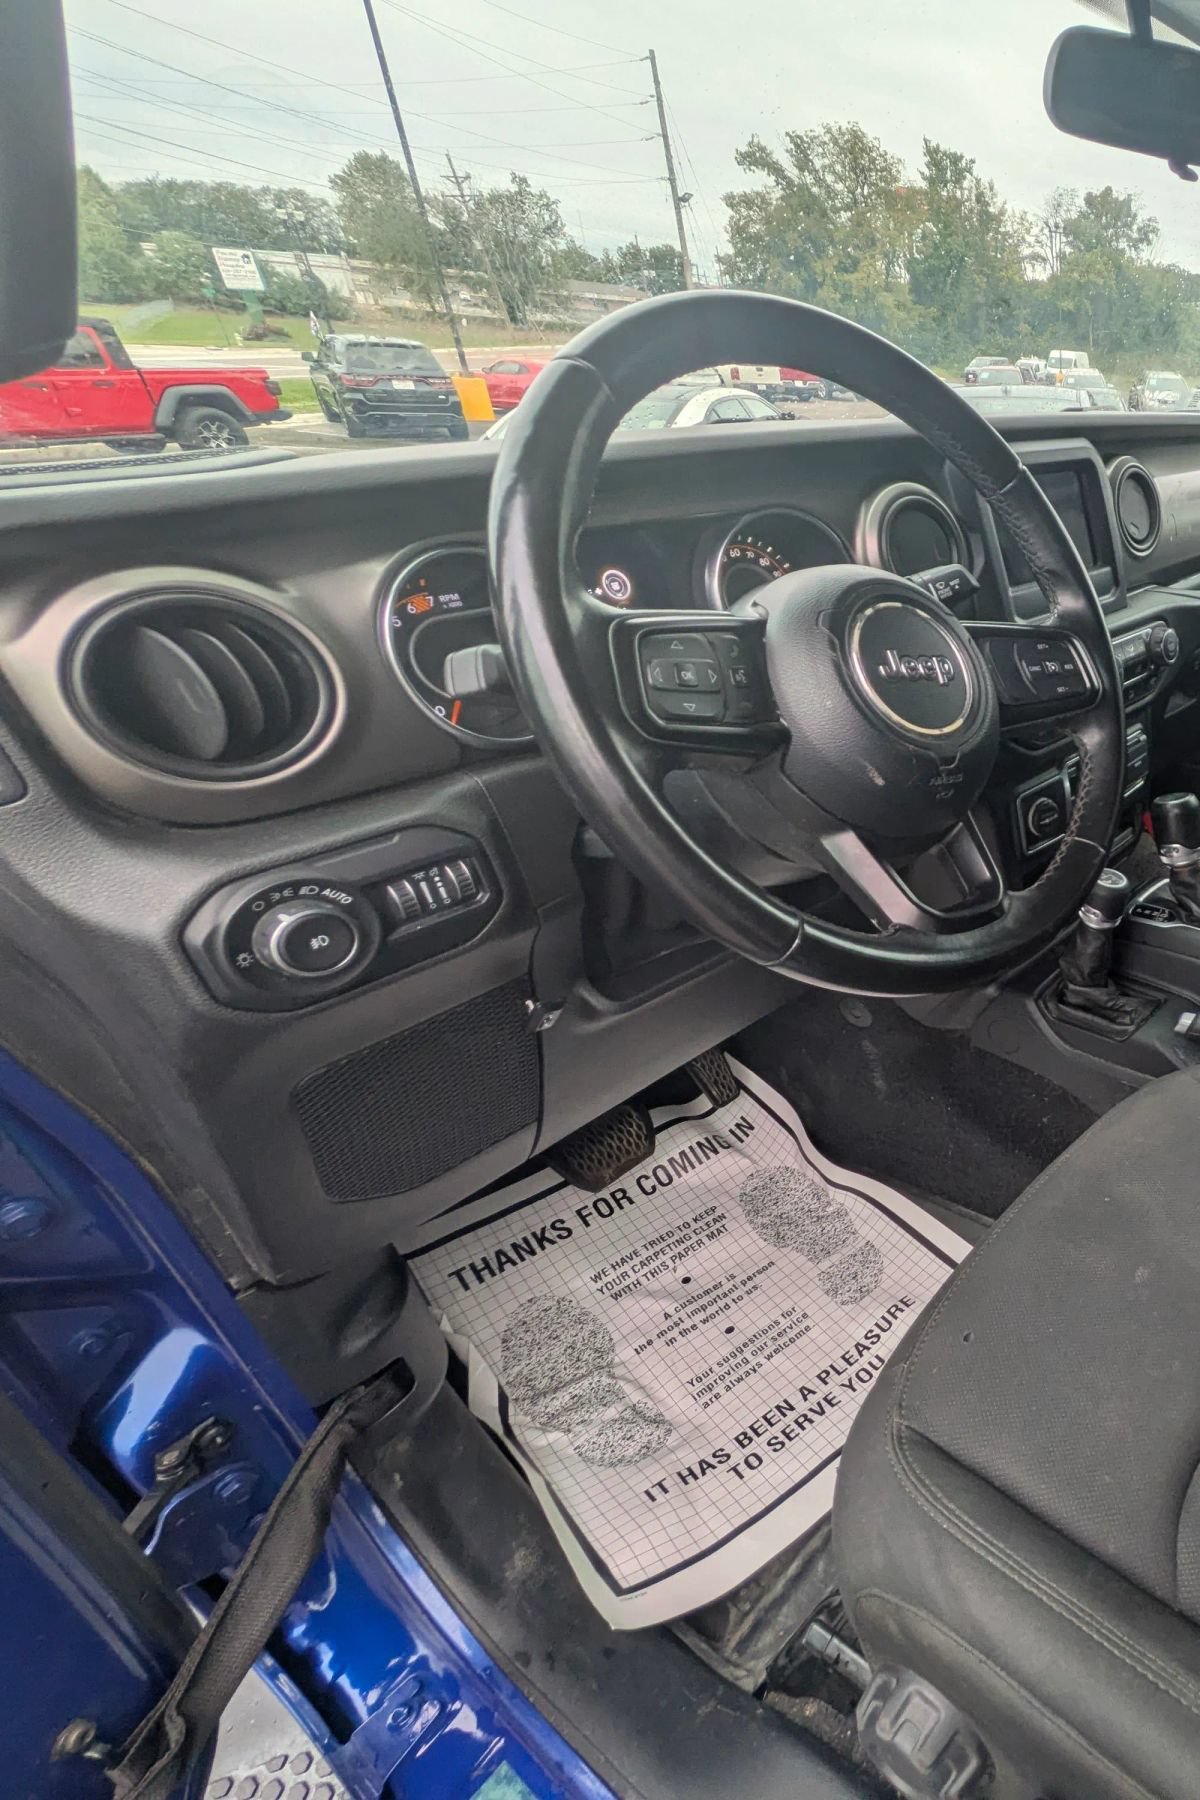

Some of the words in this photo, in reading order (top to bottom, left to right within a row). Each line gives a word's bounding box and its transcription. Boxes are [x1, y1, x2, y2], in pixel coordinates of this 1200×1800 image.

[730, 548, 741, 557] 60
[759, 557, 770, 566] 80
[391, 615, 402, 627] 5
[407, 603, 417, 614] 6
[426, 596, 434, 607] 7
[439, 593, 460, 602] RPM
[879, 649, 955, 686] Jeep
[435, 705, 446, 717] 0
[321, 887, 353, 904] AUTO
[448, 1218, 573, 1292] THANKS
[575, 1187, 635, 1228] FOR
[636, 1134, 732, 1196] COMING
[728, 1115, 756, 1143] IN
[590, 1267, 611, 1284] WE
[611, 1248, 642, 1271] HAVE
[641, 1230, 675, 1252] TRIED
[675, 1221, 691, 1233] TO
[692, 1205, 718, 1224] KEEP
[596, 1271, 631, 1296] YOUR
[631, 1233, 692, 1274] CARPETING
[693, 1212, 727, 1236] CLEAN
[610, 1278, 642, 1301] WITH
[641, 1261, 670, 1282] THIS
[670, 1239, 706, 1264] PAPER
[706, 1223, 729, 1242] MAT
[634, 1338, 654, 1355] the
[656, 1316, 685, 1339] most
[685, 1283, 739, 1319] important
[740, 1260, 776, 1287] person
[663, 1311, 673, 1321] A
[674, 1280, 723, 1313] customer
[724, 1272, 737, 1282] is
[664, 1335, 678, 1347] in
[678, 1322, 699, 1338] the
[699, 1303, 731, 1325] world
[731, 1294, 744, 1305] to
[686, 1365, 715, 1388] Your
[716, 1318, 782, 1368] suggestions
[780, 1305, 798, 1320] for
[691, 1355, 750, 1401] improving
[750, 1339, 770, 1357] our
[770, 1311, 809, 1342] service
[644, 1477, 670, 1503] IT
[676, 1447, 732, 1486] HAS
[733, 1398, 796, 1449] BEEN
[798, 1385, 818, 1402] A
[816, 1295, 917, 1386] PLEASURE
[702, 1391, 722, 1410] are
[723, 1360, 763, 1393] always
[726, 1452, 764, 1480] TO
[766, 1391, 842, 1453] SERVE
[840, 1353, 886, 1393] YOU
